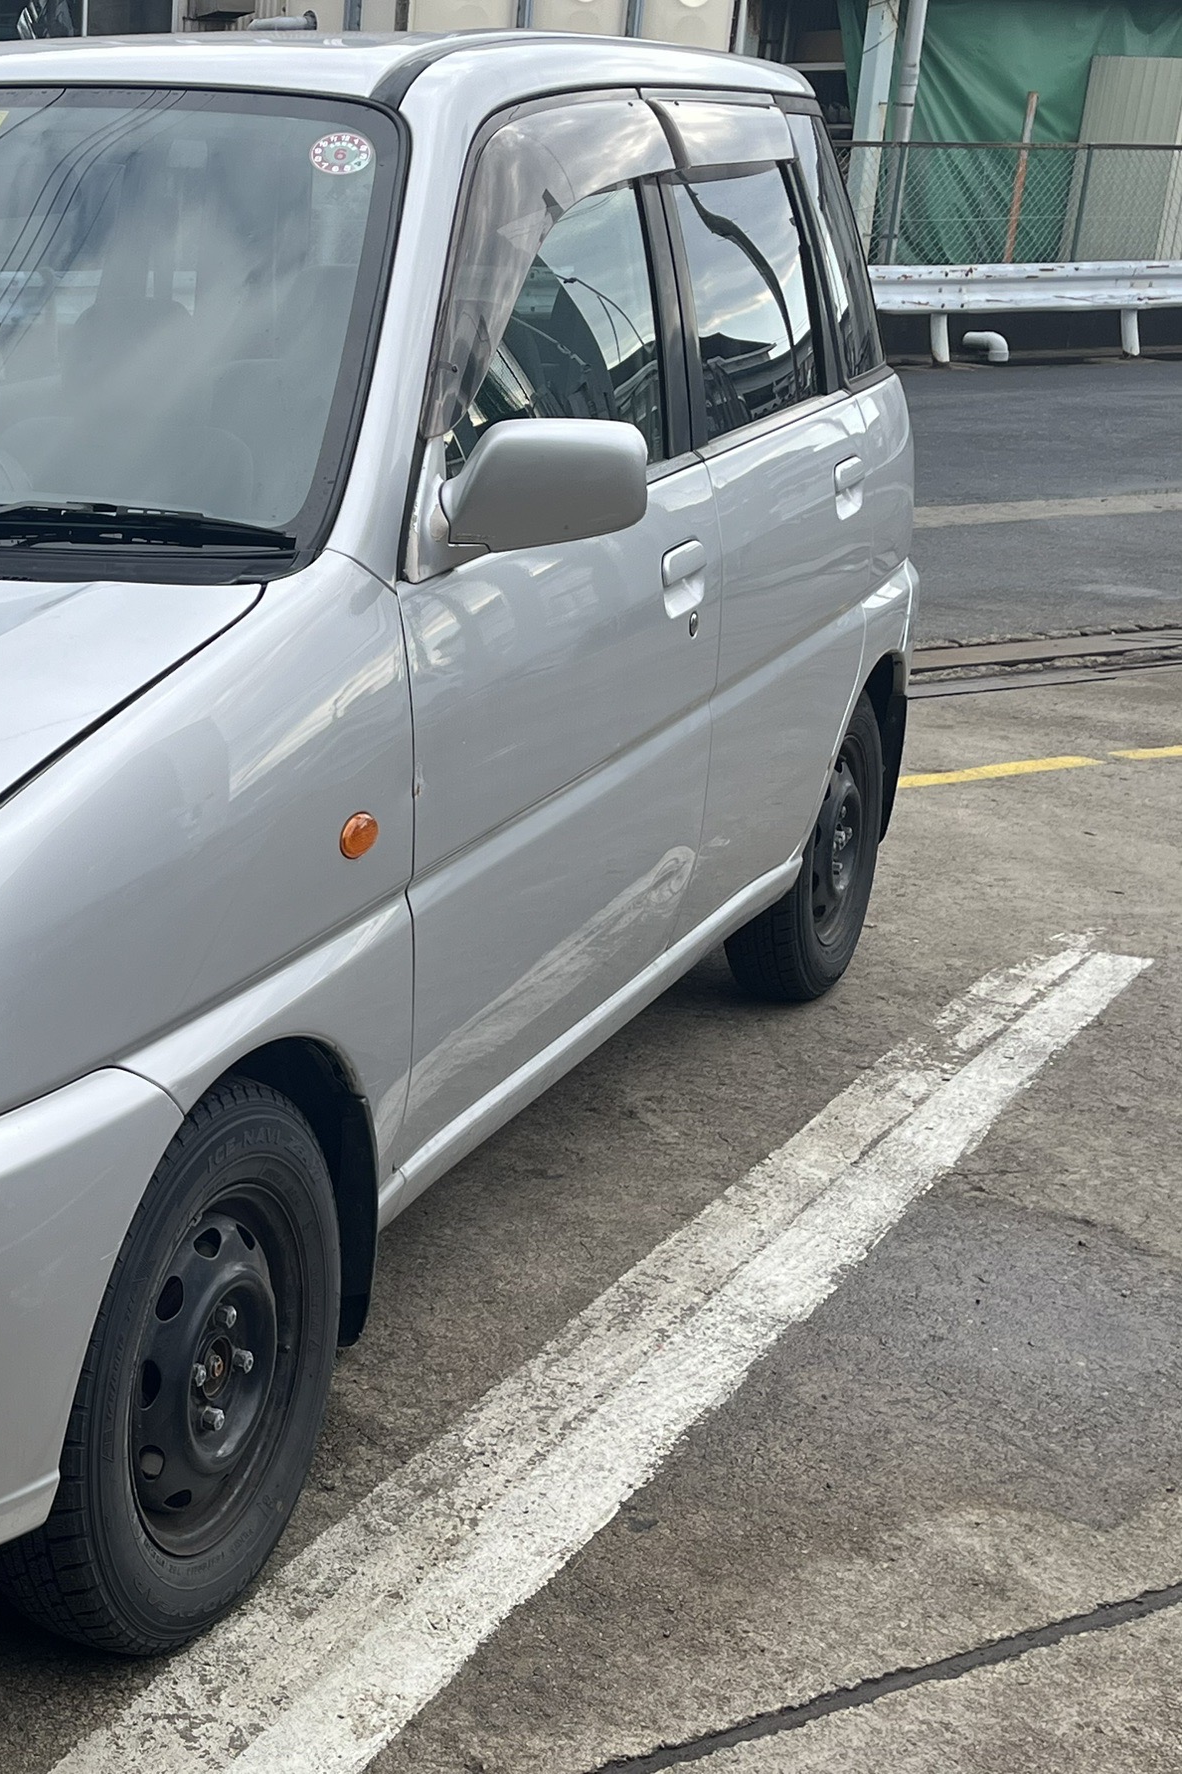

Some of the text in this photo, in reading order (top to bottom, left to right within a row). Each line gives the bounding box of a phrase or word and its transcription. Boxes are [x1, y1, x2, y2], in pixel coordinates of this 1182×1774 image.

[334, 148, 347, 161] 6
[207, 1136, 236, 1174] ICE
[242, 1126, 281, 1148] NAVI
